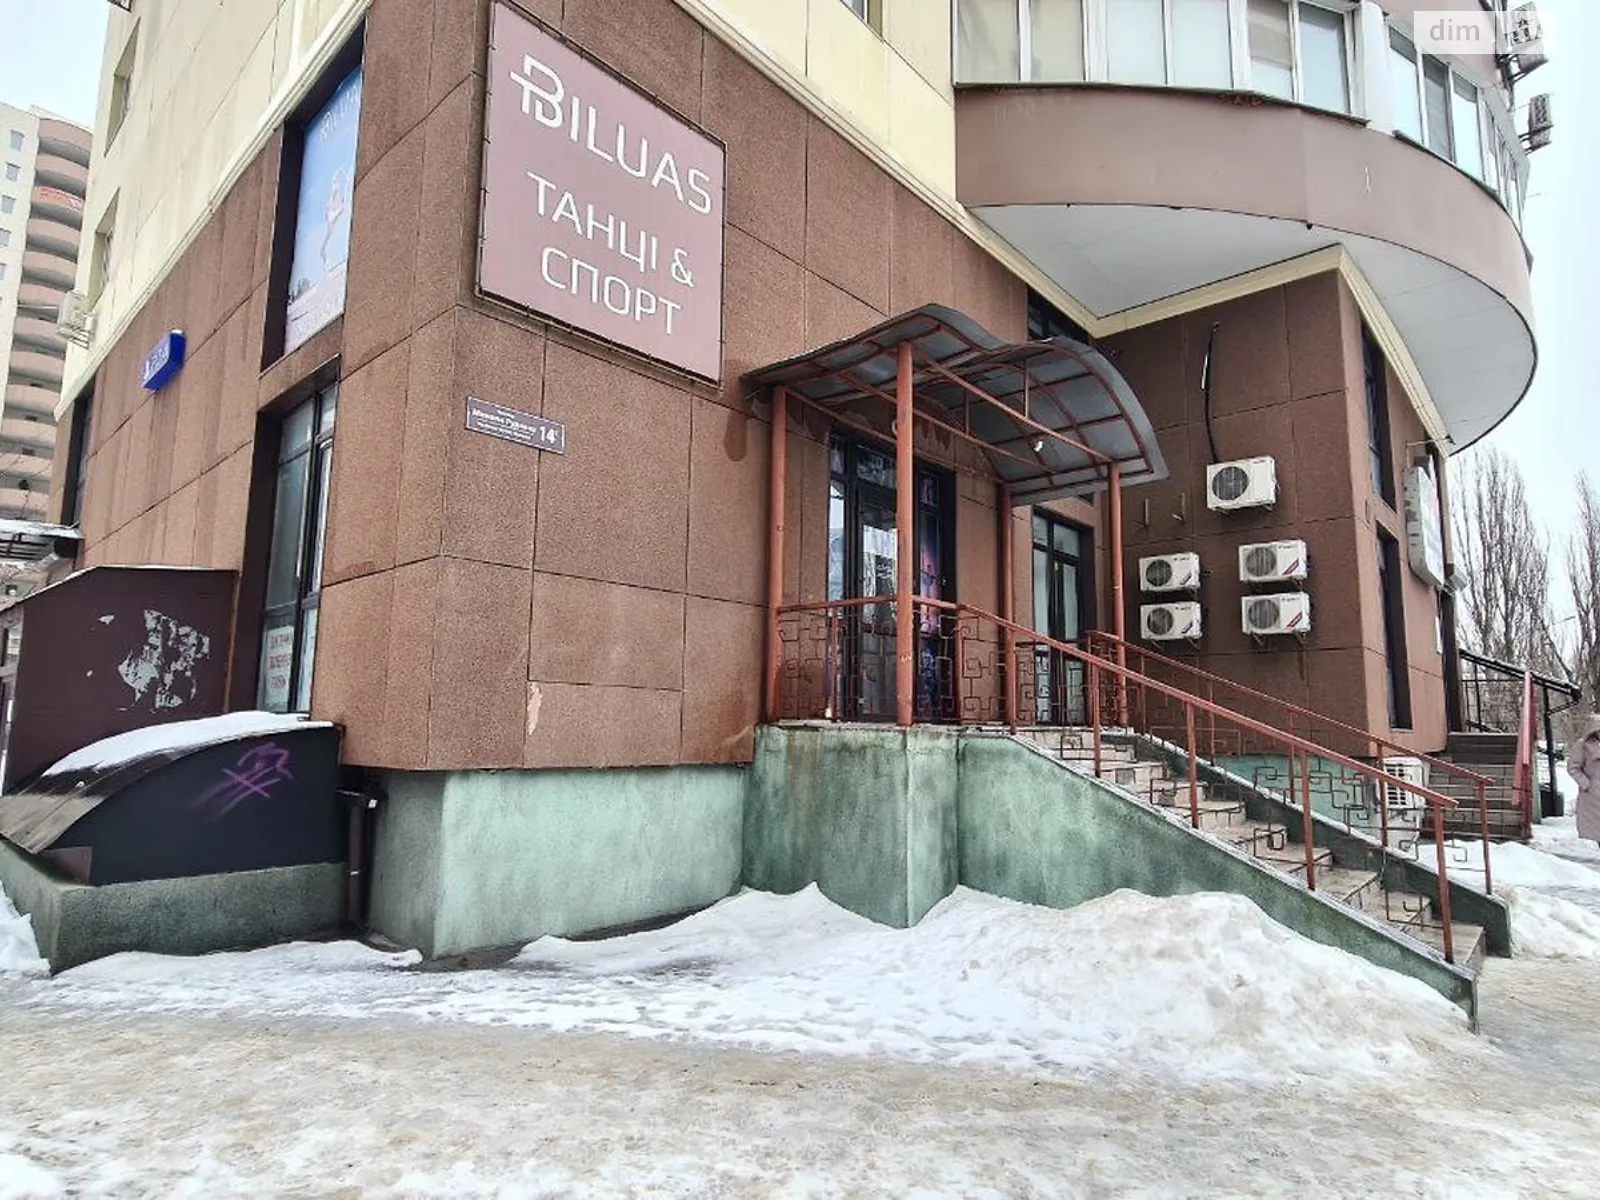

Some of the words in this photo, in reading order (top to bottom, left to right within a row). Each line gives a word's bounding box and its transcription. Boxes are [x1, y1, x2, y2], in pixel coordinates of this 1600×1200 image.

[510, 54, 712, 215] BILUAS
[527, 171, 658, 273] ТАНЦІ
[670, 248, 694, 287] &
[541, 247, 682, 334] СПОРТ
